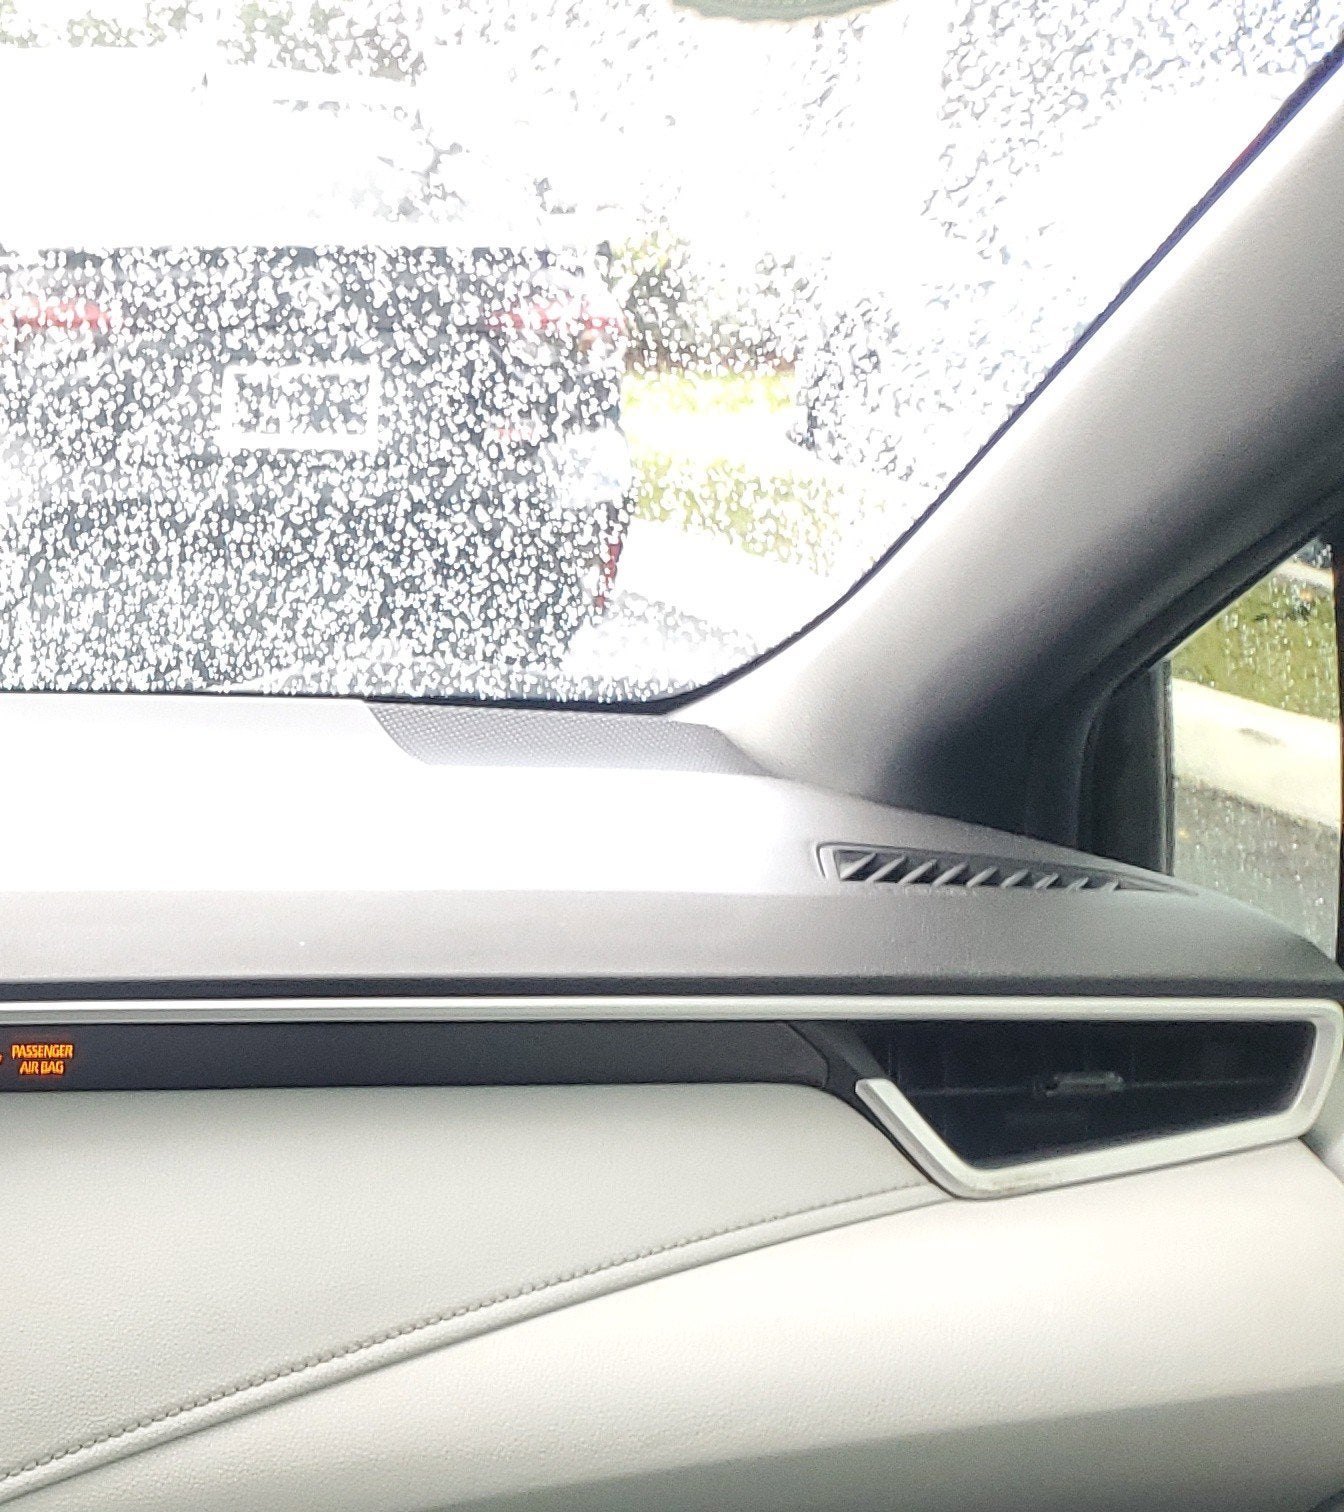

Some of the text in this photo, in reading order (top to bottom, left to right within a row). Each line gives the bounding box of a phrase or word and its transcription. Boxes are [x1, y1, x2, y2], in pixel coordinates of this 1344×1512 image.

[11, 1043, 74, 1060] PASSENGER
[19, 1060, 65, 1075] AIR BAG
